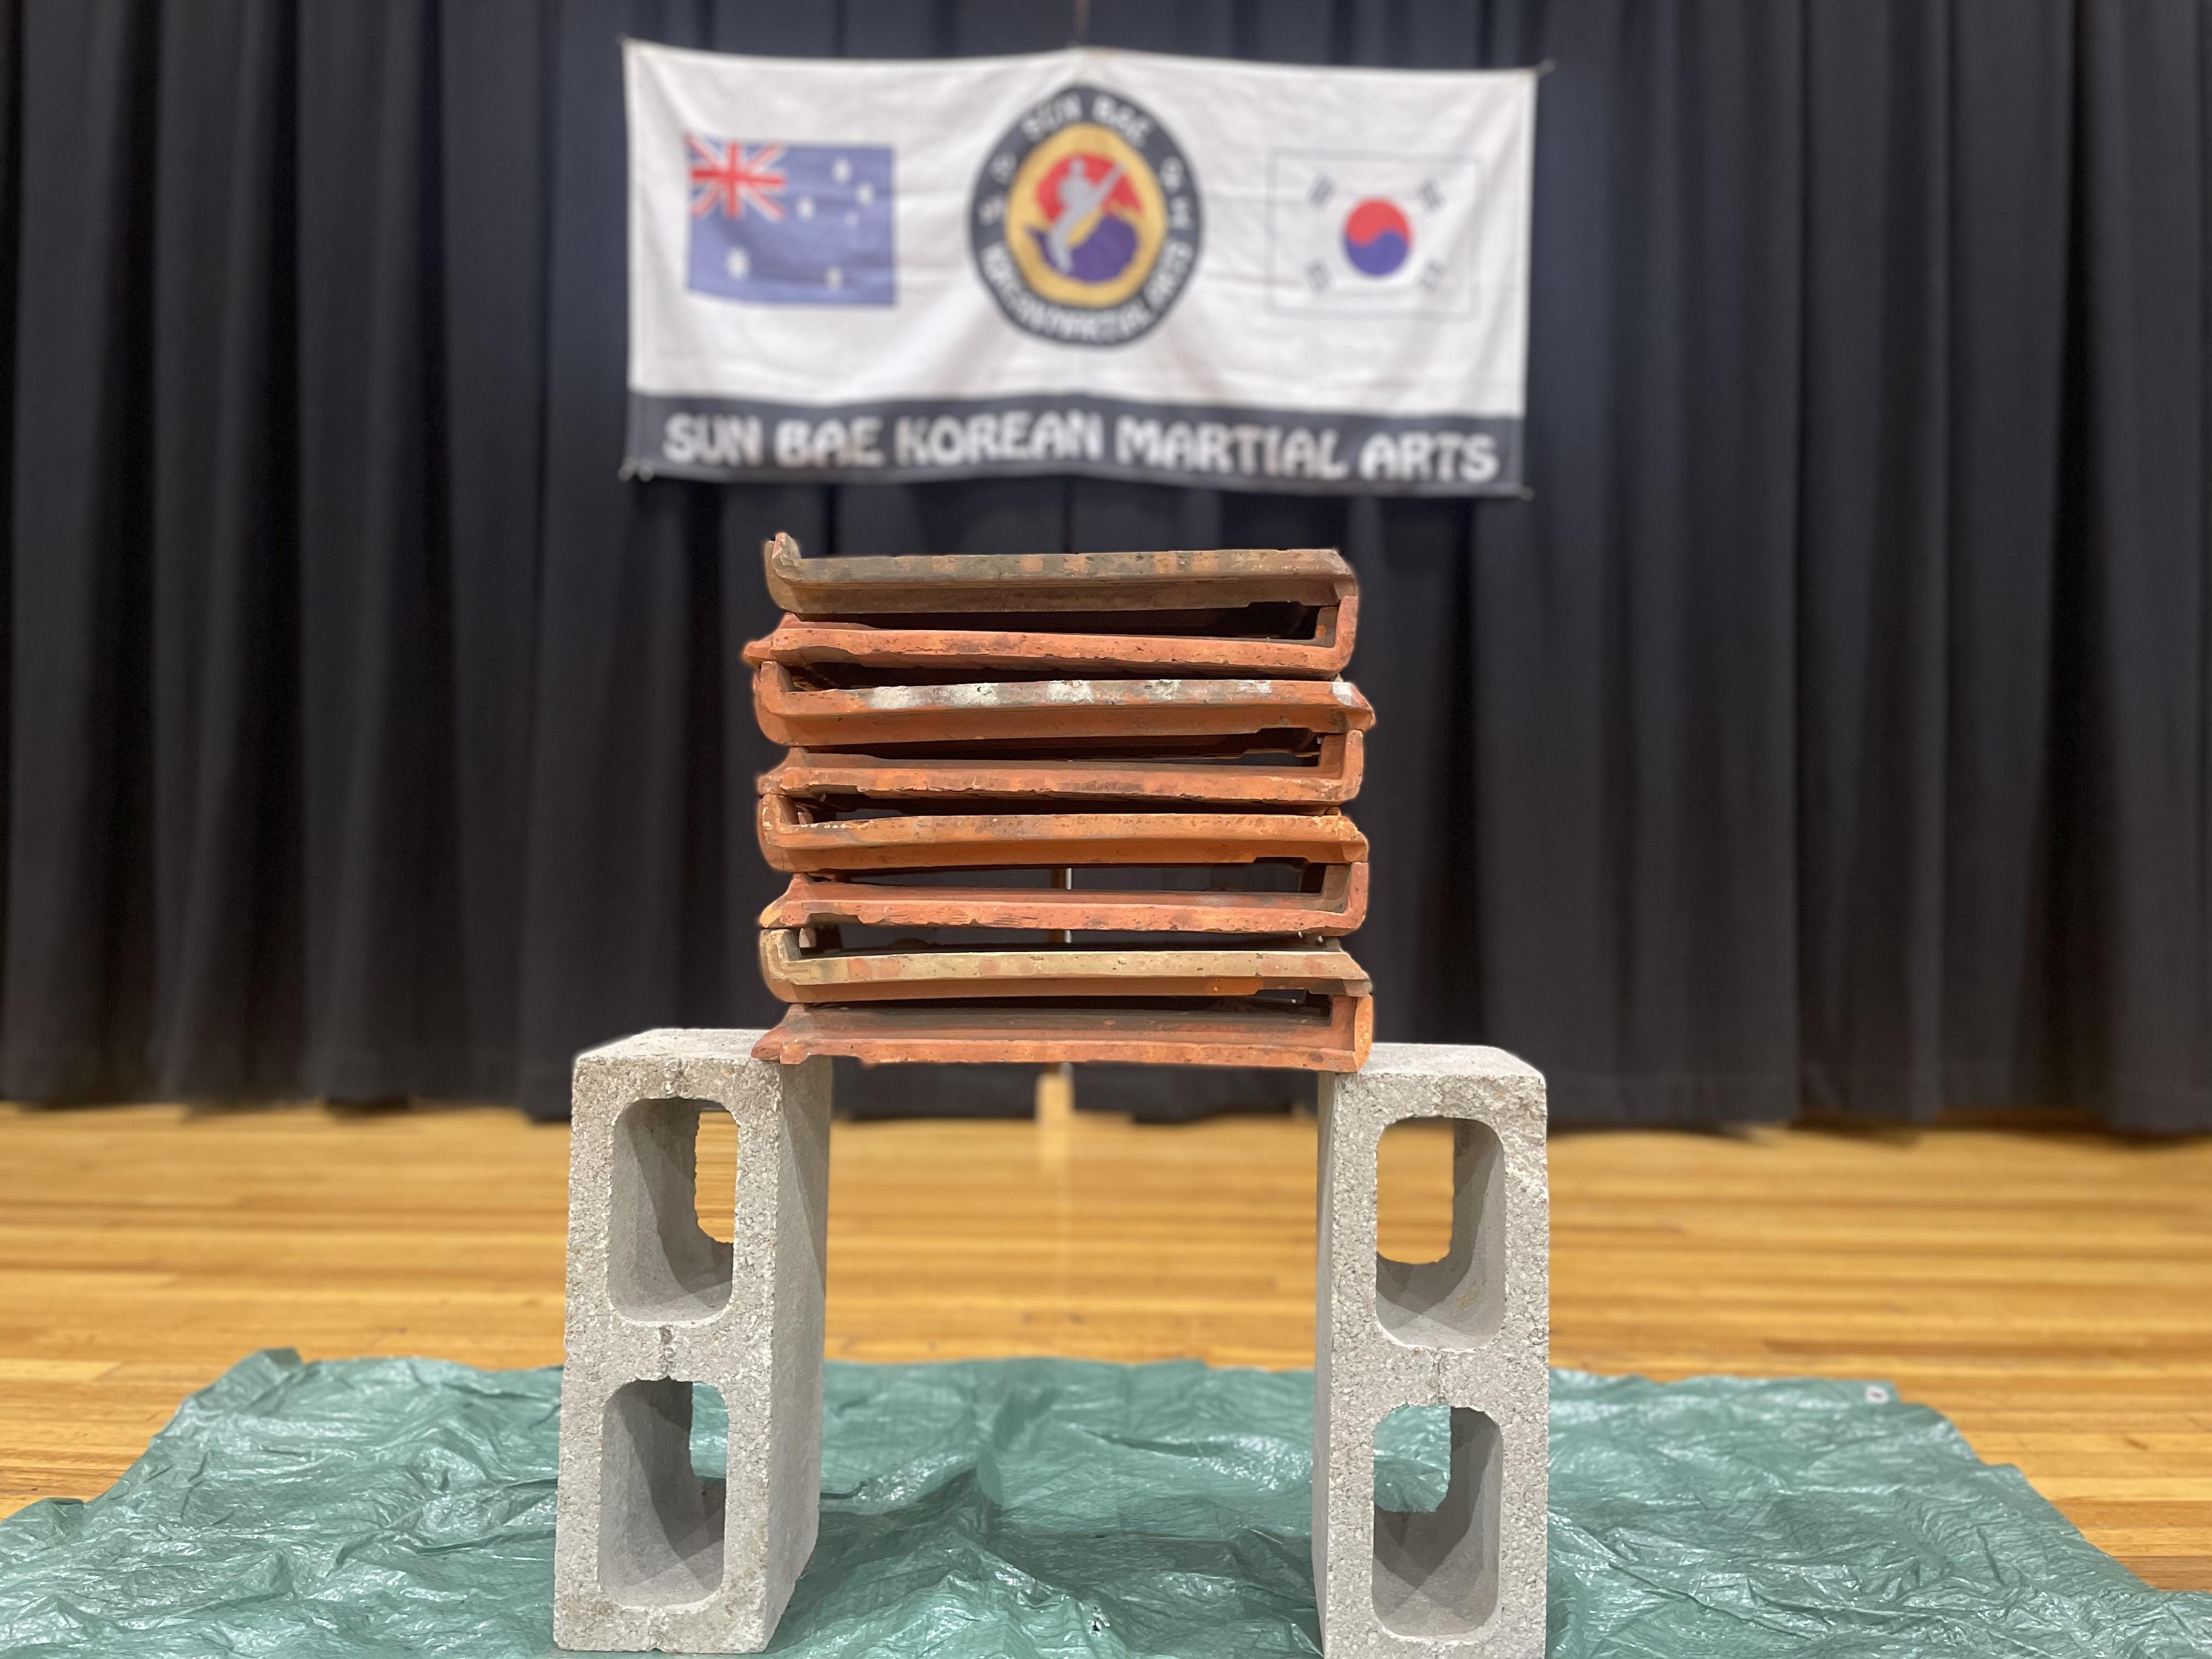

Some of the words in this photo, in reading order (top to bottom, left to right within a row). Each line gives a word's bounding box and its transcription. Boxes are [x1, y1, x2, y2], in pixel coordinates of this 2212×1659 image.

[1021, 93, 1082, 141] SUN
[1092, 95, 1153, 146] BAE
[1144, 239, 1193, 312] ARTS
[663, 413, 763, 467] SUN
[774, 419, 884, 467] BAE
[894, 409, 1104, 466] KOREAN
[1115, 414, 1350, 481] MARTIAL
[1358, 432, 1500, 483] ARTS
